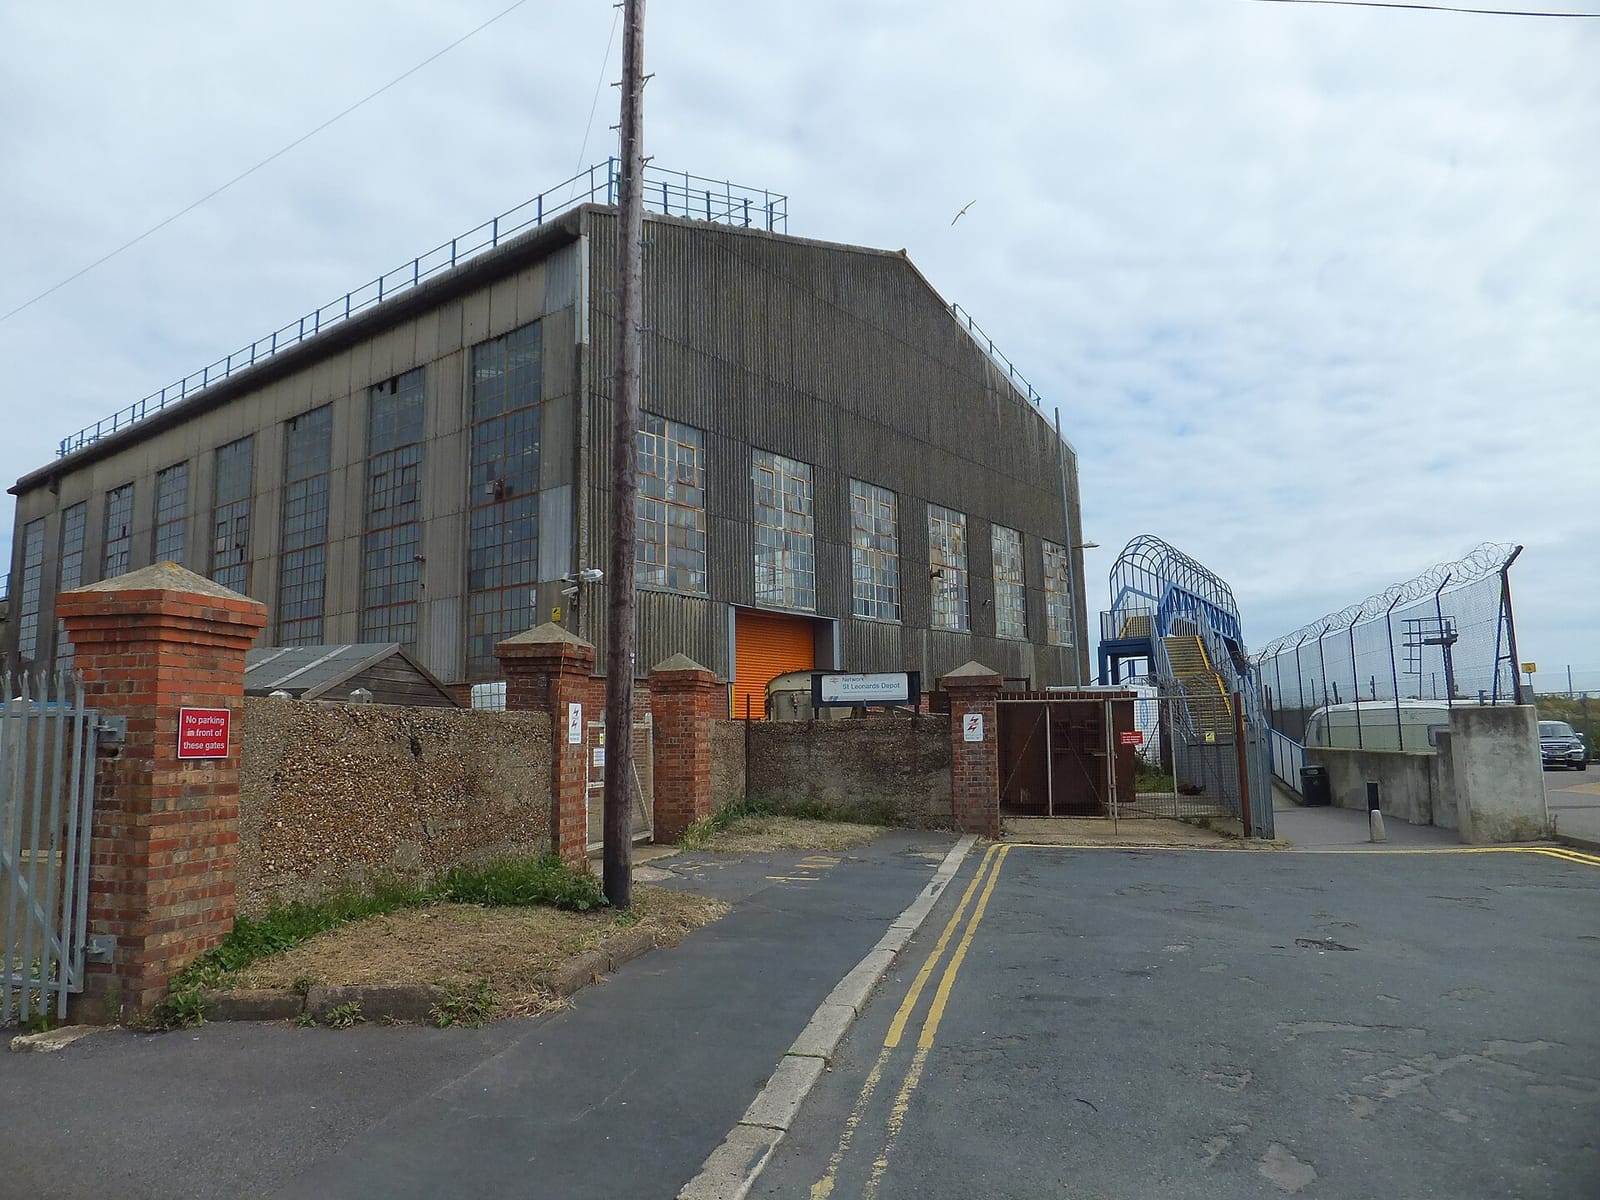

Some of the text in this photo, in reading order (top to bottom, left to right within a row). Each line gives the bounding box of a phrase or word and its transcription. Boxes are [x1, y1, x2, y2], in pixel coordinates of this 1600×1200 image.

[881, 682, 900, 690] Depot
[185, 715, 225, 726] No parking
[186, 728, 222, 737] in front of
[183, 741, 225, 751] these gates
